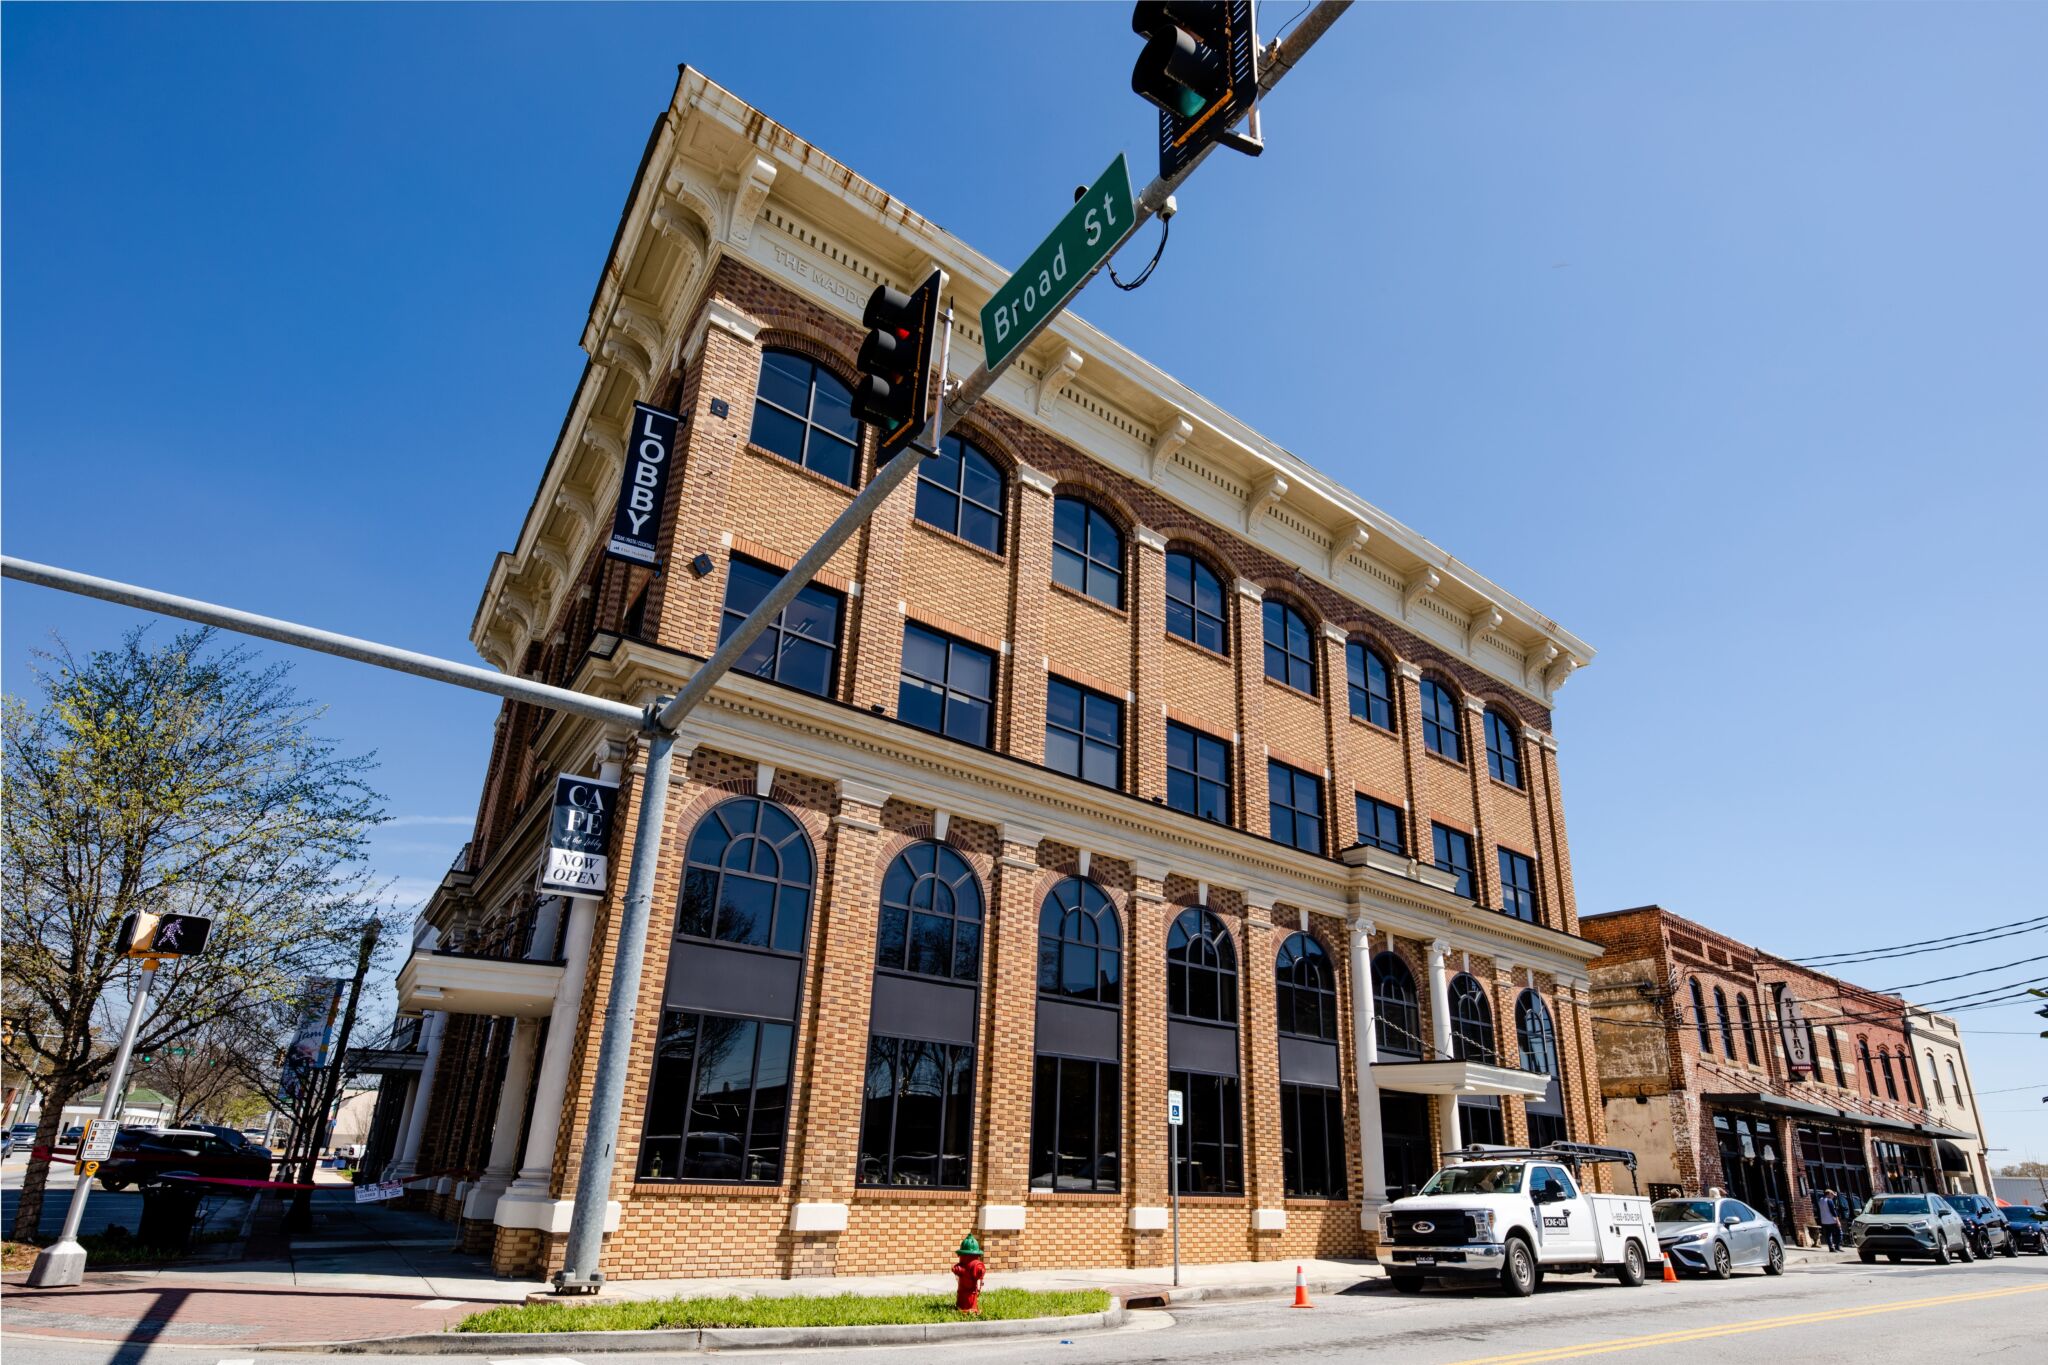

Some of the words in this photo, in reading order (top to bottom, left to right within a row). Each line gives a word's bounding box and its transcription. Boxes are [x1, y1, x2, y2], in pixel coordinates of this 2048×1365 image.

[775, 245, 808, 277] THE
[813, 267, 869, 310] MADDO
[994, 243, 1067, 343] Broad
[1084, 192, 1116, 246] St
[627, 414, 665, 535] LOBBY
[553, 868, 600, 885] OPEN
[560, 854, 598, 869] NOW
